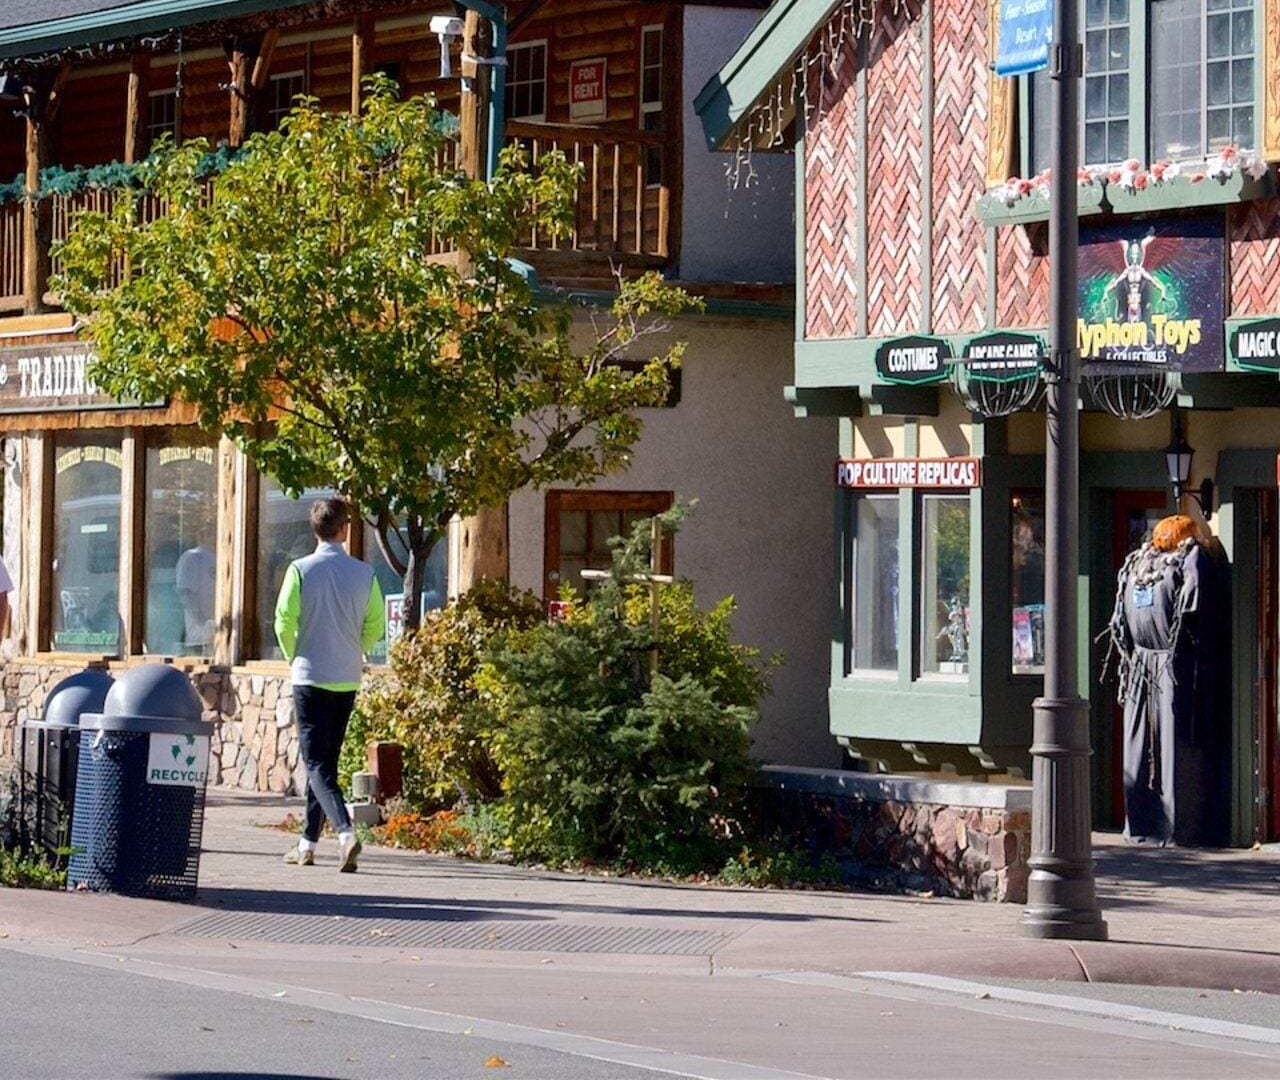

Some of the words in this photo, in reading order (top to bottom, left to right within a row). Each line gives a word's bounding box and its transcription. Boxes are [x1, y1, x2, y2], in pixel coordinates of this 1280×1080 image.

[578, 67, 597, 81] FOR
[574, 81, 600, 100] RENT
[1151, 314, 1202, 355] Toys
[1238, 331, 1276, 358] MAGIC
[888, 346, 938, 372] COSTUMES
[967, 344, 1005, 370] ARCADE
[1006, 343, 1039, 369] GAMES
[838, 461, 862, 485] POP
[863, 460, 917, 485] CULTURE
[919, 461, 975, 485] REPLICAS
[150, 769, 206, 783] RECYCLE
